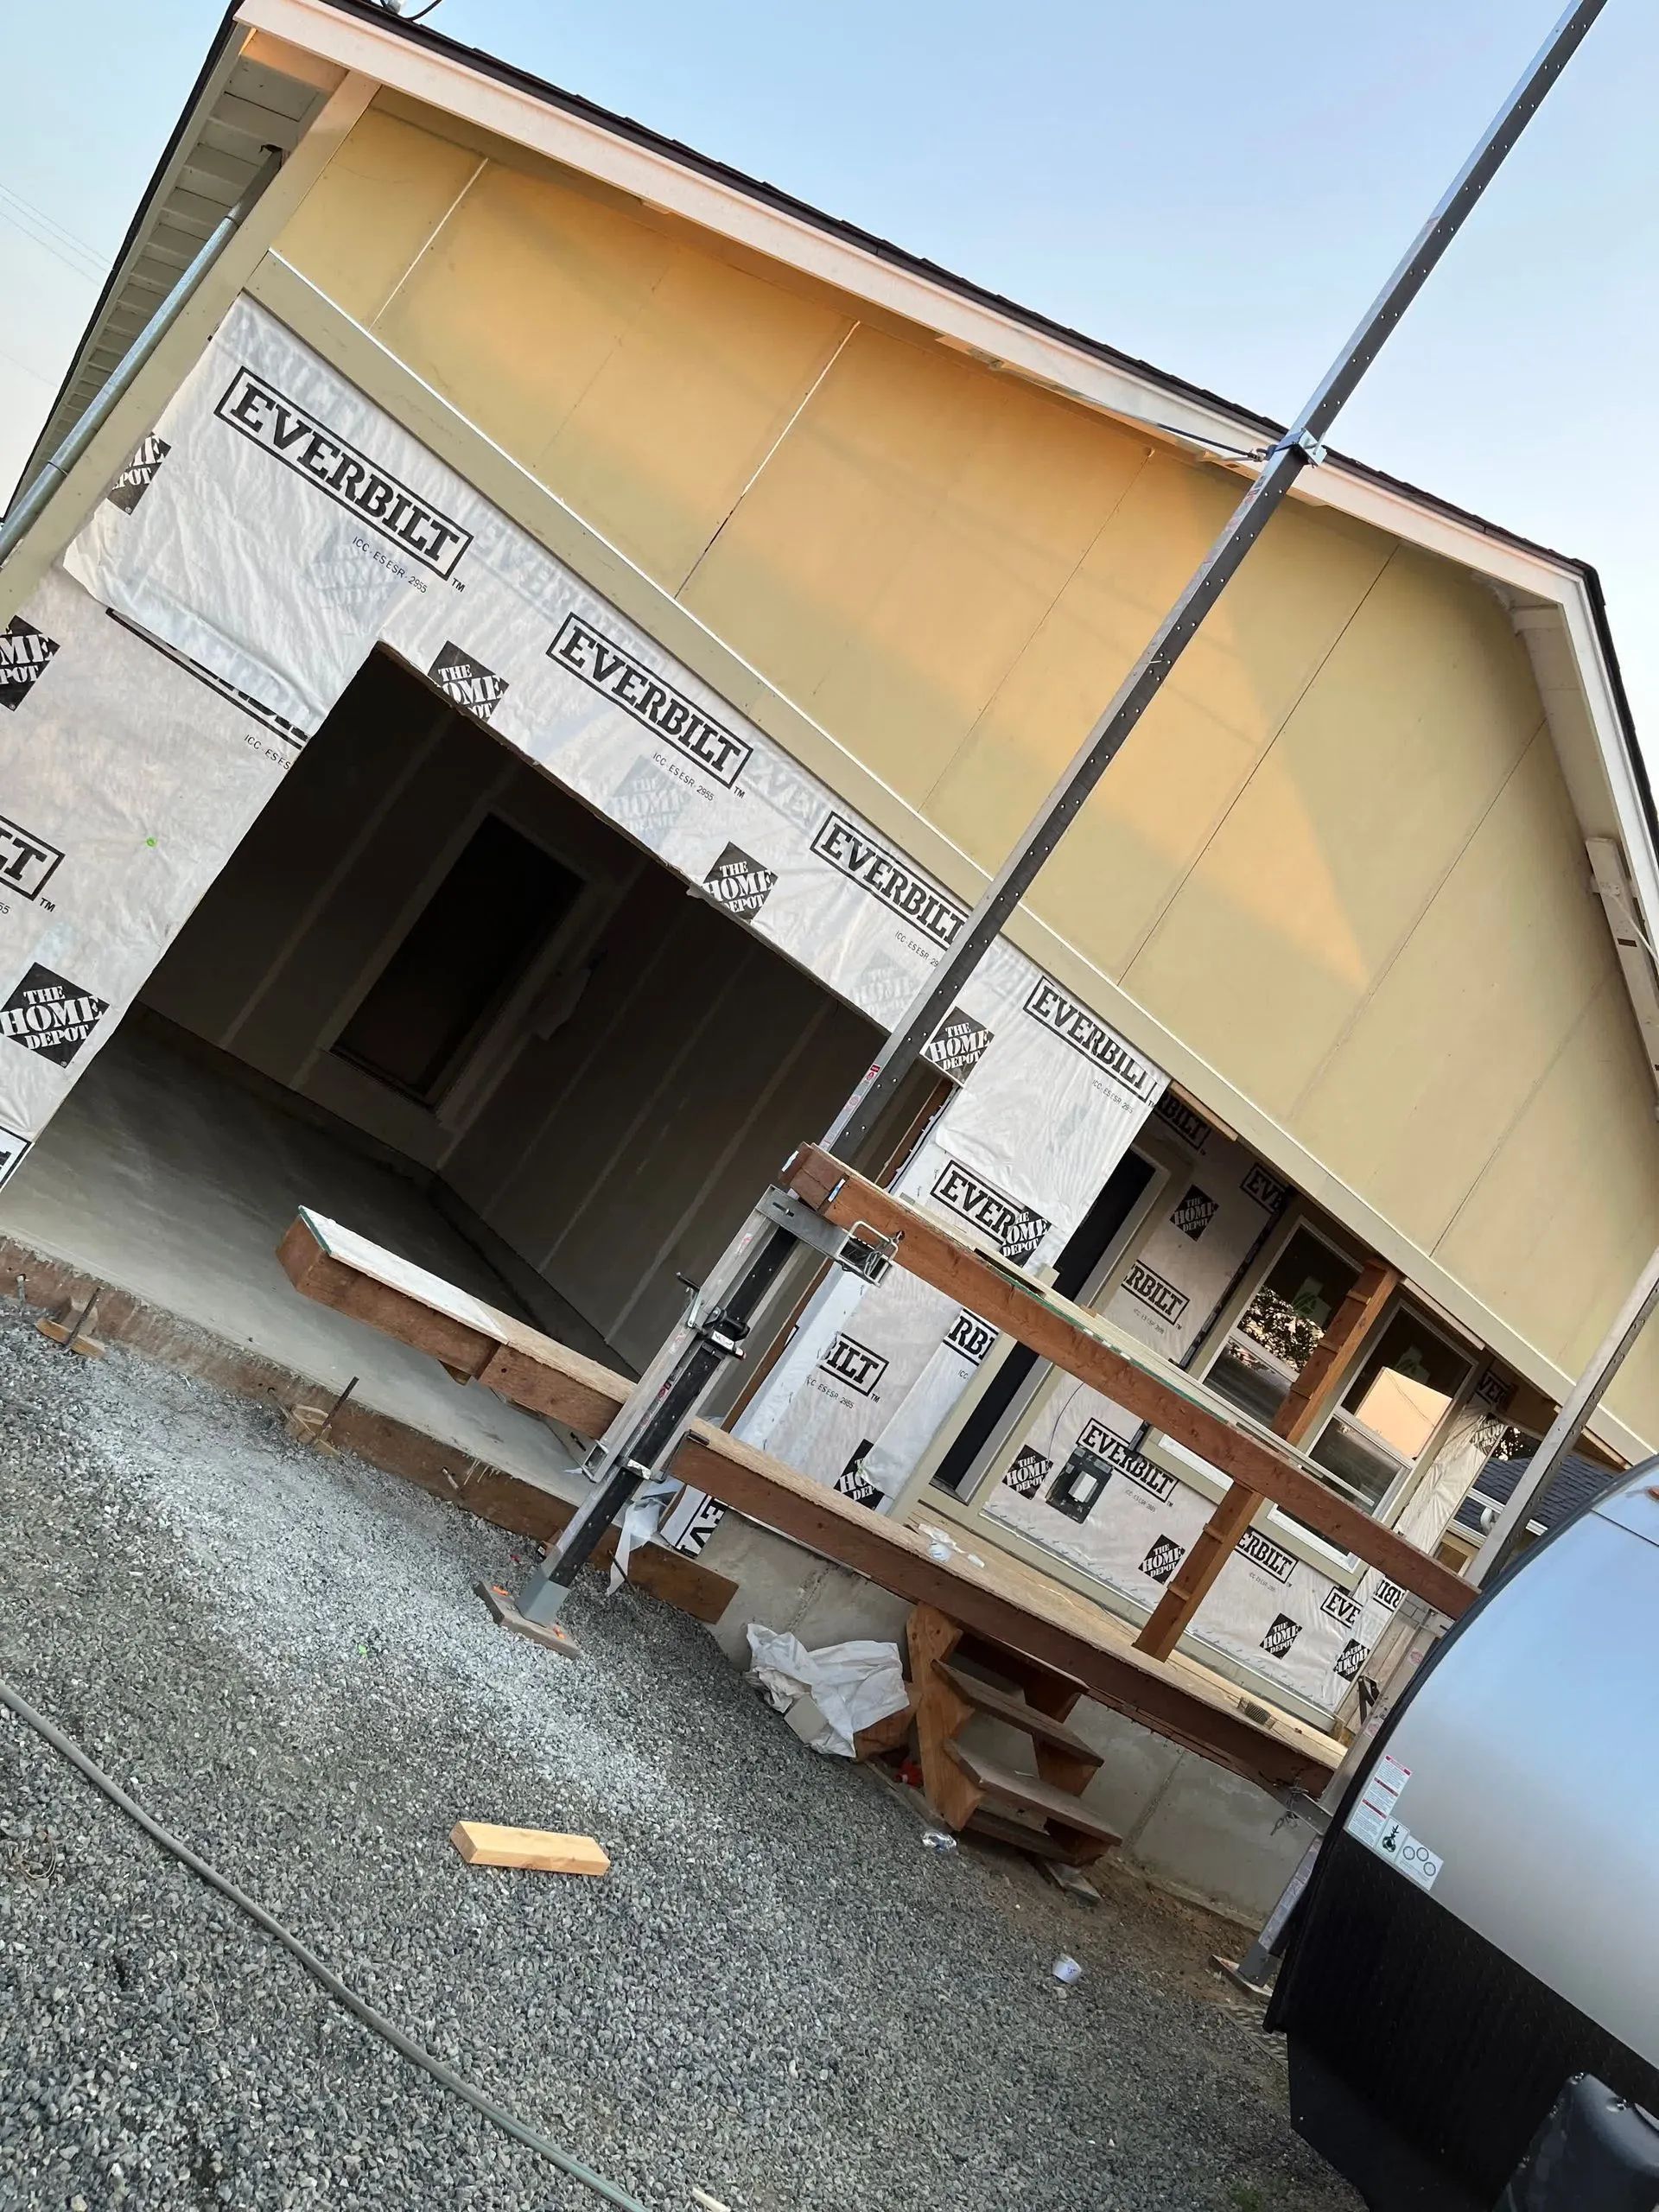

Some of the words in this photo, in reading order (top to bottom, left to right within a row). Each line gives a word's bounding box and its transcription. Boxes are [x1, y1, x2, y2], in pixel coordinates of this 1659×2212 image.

[231, 382, 460, 562] EVERBILT
[451, 577, 466, 593] TM
[437, 664, 473, 682] THE
[442, 675, 504, 705] OME
[559, 626, 741, 772] EVERBILT
[734, 785, 746, 799] TM
[719, 861, 748, 878] THE
[702, 868, 773, 901] HOME
[821, 823, 965, 944] EVERBILT
[39, 897, 56, 912] TM
[724, 893, 764, 912] EPOT
[23, 985, 66, 1005] THE
[0, 995, 104, 1037] HOME
[24, 1024, 89, 1050] DEPOT
[945, 1022, 971, 1038] THE
[929, 1029, 989, 1063] HOME
[943, 1050, 982, 1071] DEPOT
[939, 1169, 1016, 1241] EVER
[1174, 1202, 1214, 1225] HOME
[1003, 1218, 1048, 1245] OME
[1001, 1237, 1039, 1257] DEPOT
[1124, 1264, 1183, 1316] RBILT
[870, 1393, 880, 1403] TM
[1017, 1455, 1036, 1468] THE
[1083, 1424, 1174, 1494] EVERBILT
[839, 1471, 868, 1494] HO
[1006, 1459, 1050, 1486] HOME
[1015, 1474, 1044, 1492] DEPOT
[852, 1485, 874, 1501] DEP
[1142, 1546, 1182, 1572] HOME
[1153, 1543, 1170, 1555] THE
[1150, 1561, 1177, 1578] DEPOT
[1263, 1624, 1299, 1649] HOME
[1272, 1621, 1288, 1633] THE
[1270, 1638, 1294, 1654] DEPOT
